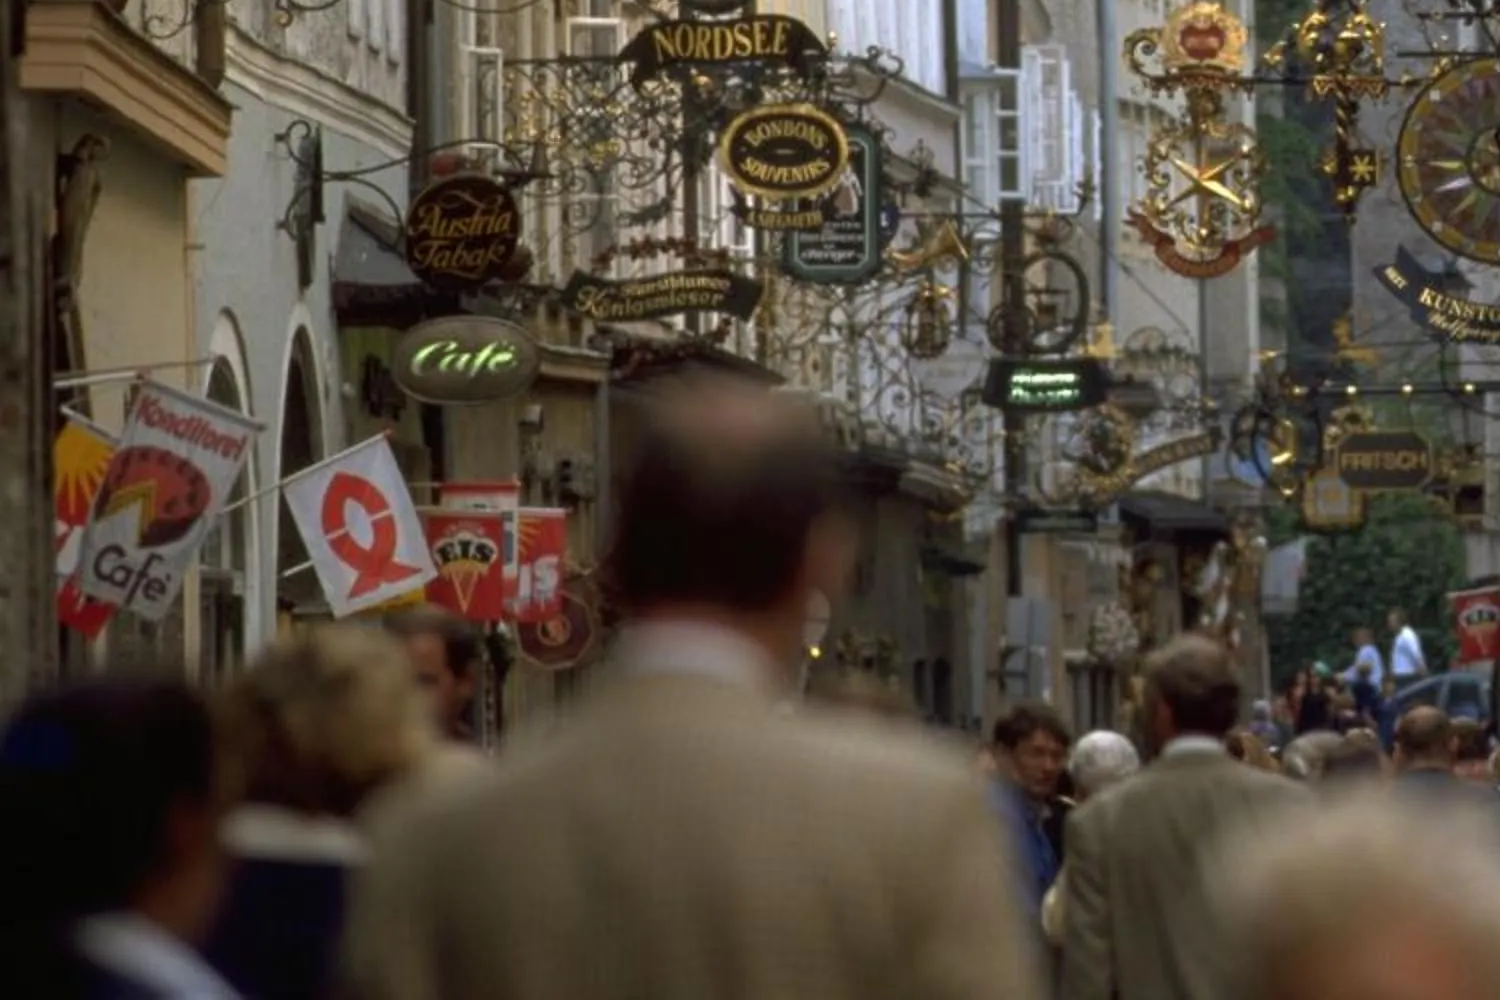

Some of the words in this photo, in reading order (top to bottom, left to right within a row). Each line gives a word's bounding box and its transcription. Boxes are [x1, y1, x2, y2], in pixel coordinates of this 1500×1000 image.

[653, 21, 791, 62] NORDSEE
[744, 120, 829, 149] BONBONS
[740, 156, 830, 184] SOUVENIRS
[409, 192, 513, 237] Austria
[411, 238, 506, 274] Tabak
[135, 396, 248, 463] Konditorei
[436, 539, 496, 564] EIS
[93, 544, 172, 605] Café
